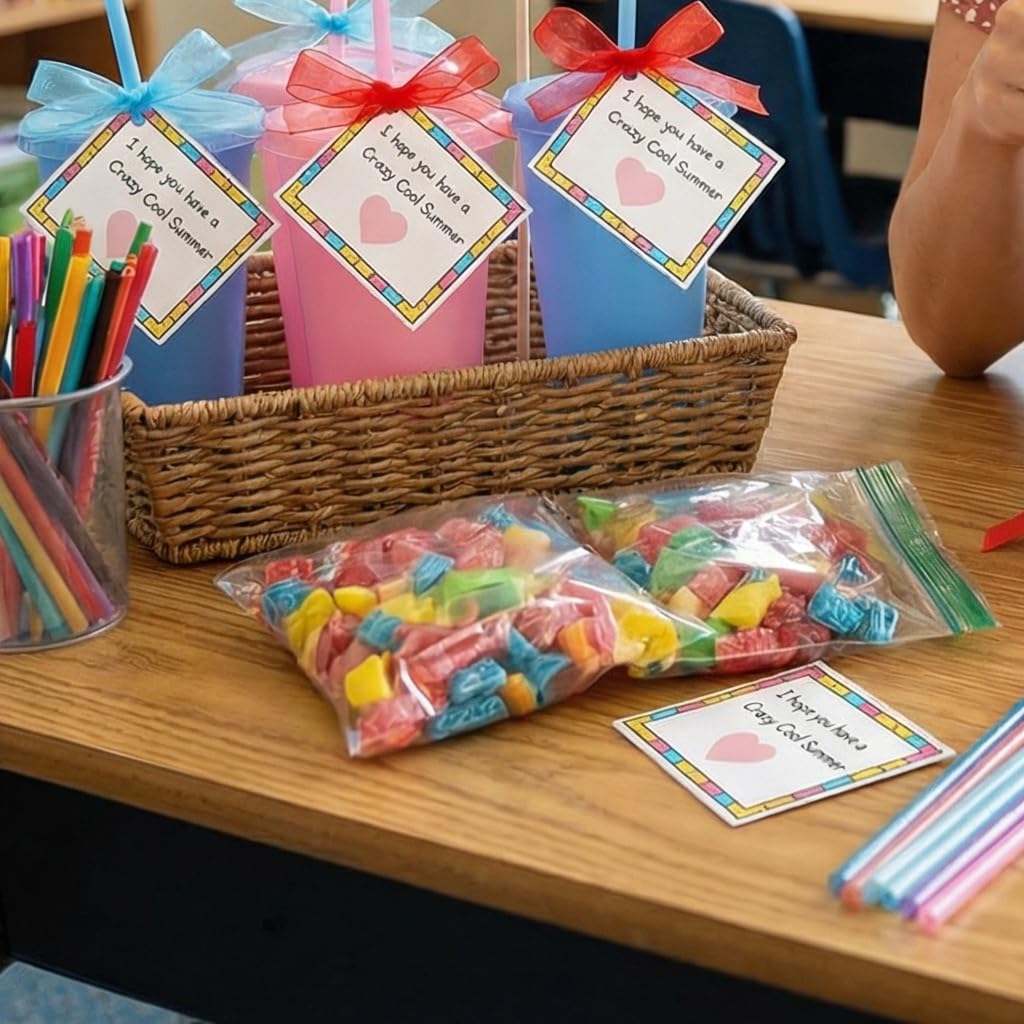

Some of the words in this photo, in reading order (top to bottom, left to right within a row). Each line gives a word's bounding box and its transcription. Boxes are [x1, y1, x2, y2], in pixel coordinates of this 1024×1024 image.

[608, 111, 646, 144] Crazy
[647, 140, 677, 165] Cool
[675, 161, 722, 199] Summer
[623, 89, 634, 102] I
[634, 95, 660, 122] hope
[660, 122, 684, 140] you
[687, 134, 712, 160] have
[715, 160, 724, 169] a
[126, 138, 139, 150] I
[137, 146, 163, 174] hope
[159, 174, 184, 194] you
[184, 190, 209, 219] have
[210, 218, 220, 228] a
[143, 193, 173, 221] Cool
[363, 147, 396, 181] Crazy
[396, 179, 426, 206] Cool
[380, 125, 393, 137] I
[411, 161, 436, 179] you
[435, 175, 460, 204] have
[461, 204, 470, 214] a
[776, 689, 794, 699] I
